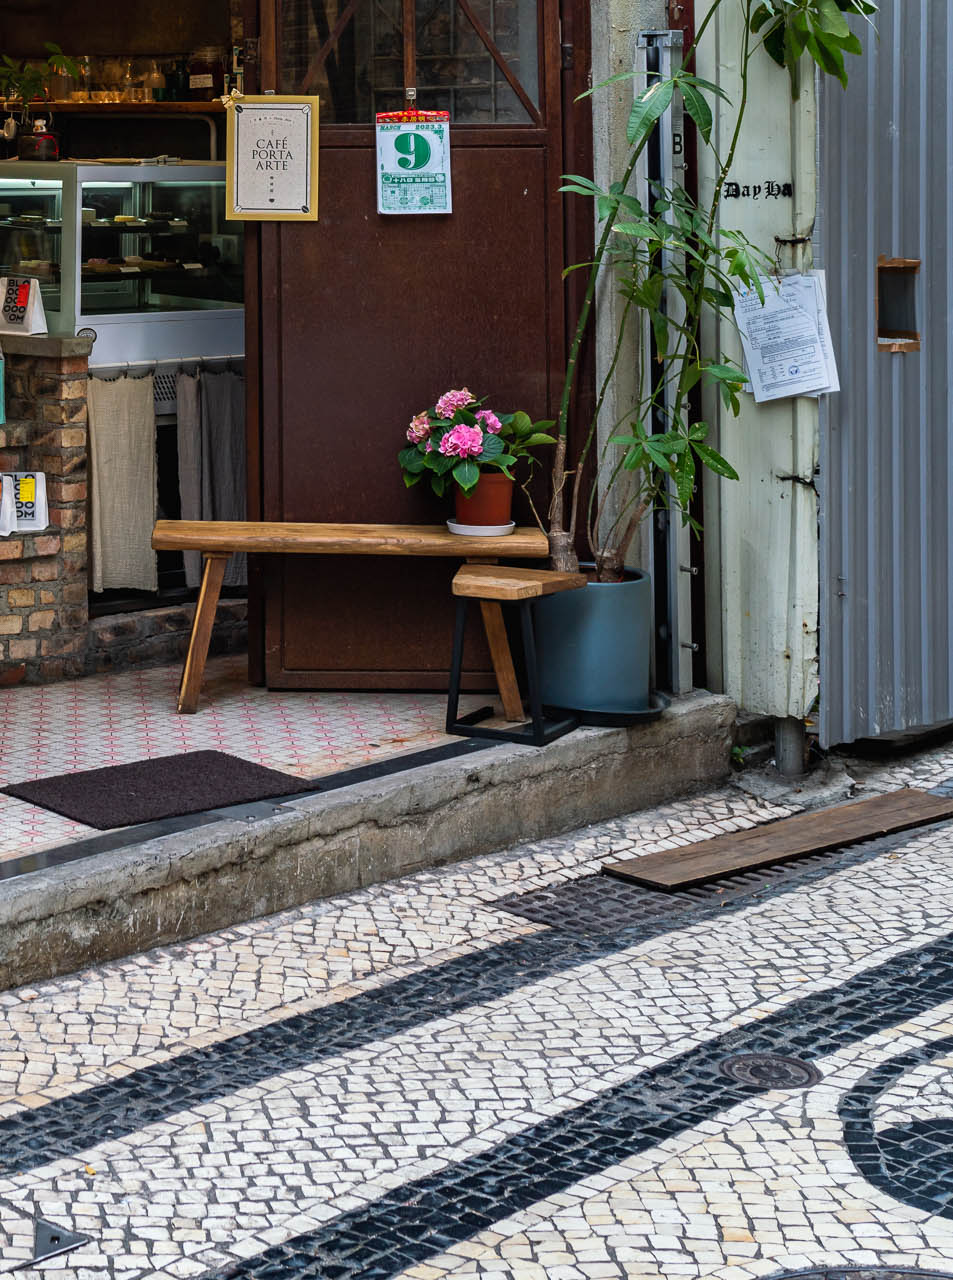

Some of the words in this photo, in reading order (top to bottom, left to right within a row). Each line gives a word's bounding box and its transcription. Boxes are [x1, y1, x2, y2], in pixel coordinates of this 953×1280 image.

[256, 137, 288, 149] CAFÉ
[672, 133, 682, 154] B
[251, 150, 293, 160] PORTA
[394, 132, 431, 170] 9
[256, 160, 288, 170] ARTE
